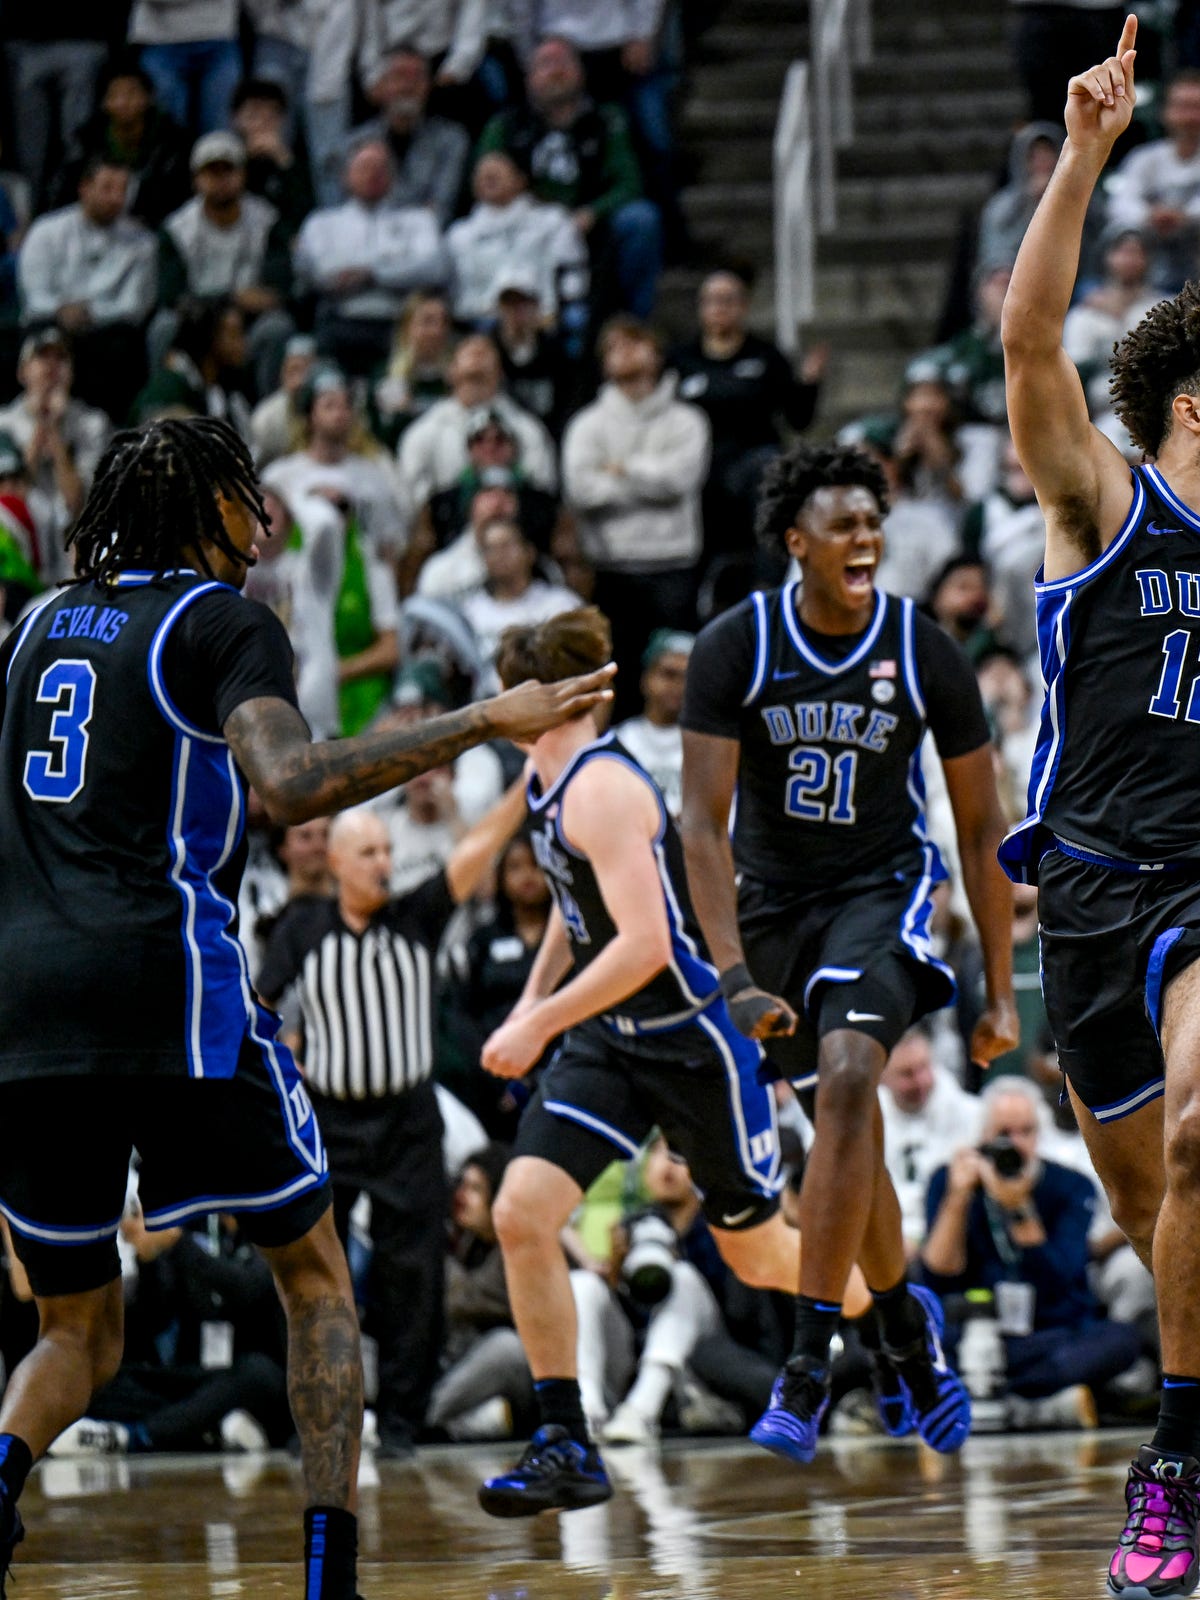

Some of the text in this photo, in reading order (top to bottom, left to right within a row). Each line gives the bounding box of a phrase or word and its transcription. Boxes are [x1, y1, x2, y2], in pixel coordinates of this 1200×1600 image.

[47, 604, 129, 644] EVANS
[22, 658, 97, 803] 3
[761, 701, 899, 752] DUKE
[785, 746, 857, 825] 21
